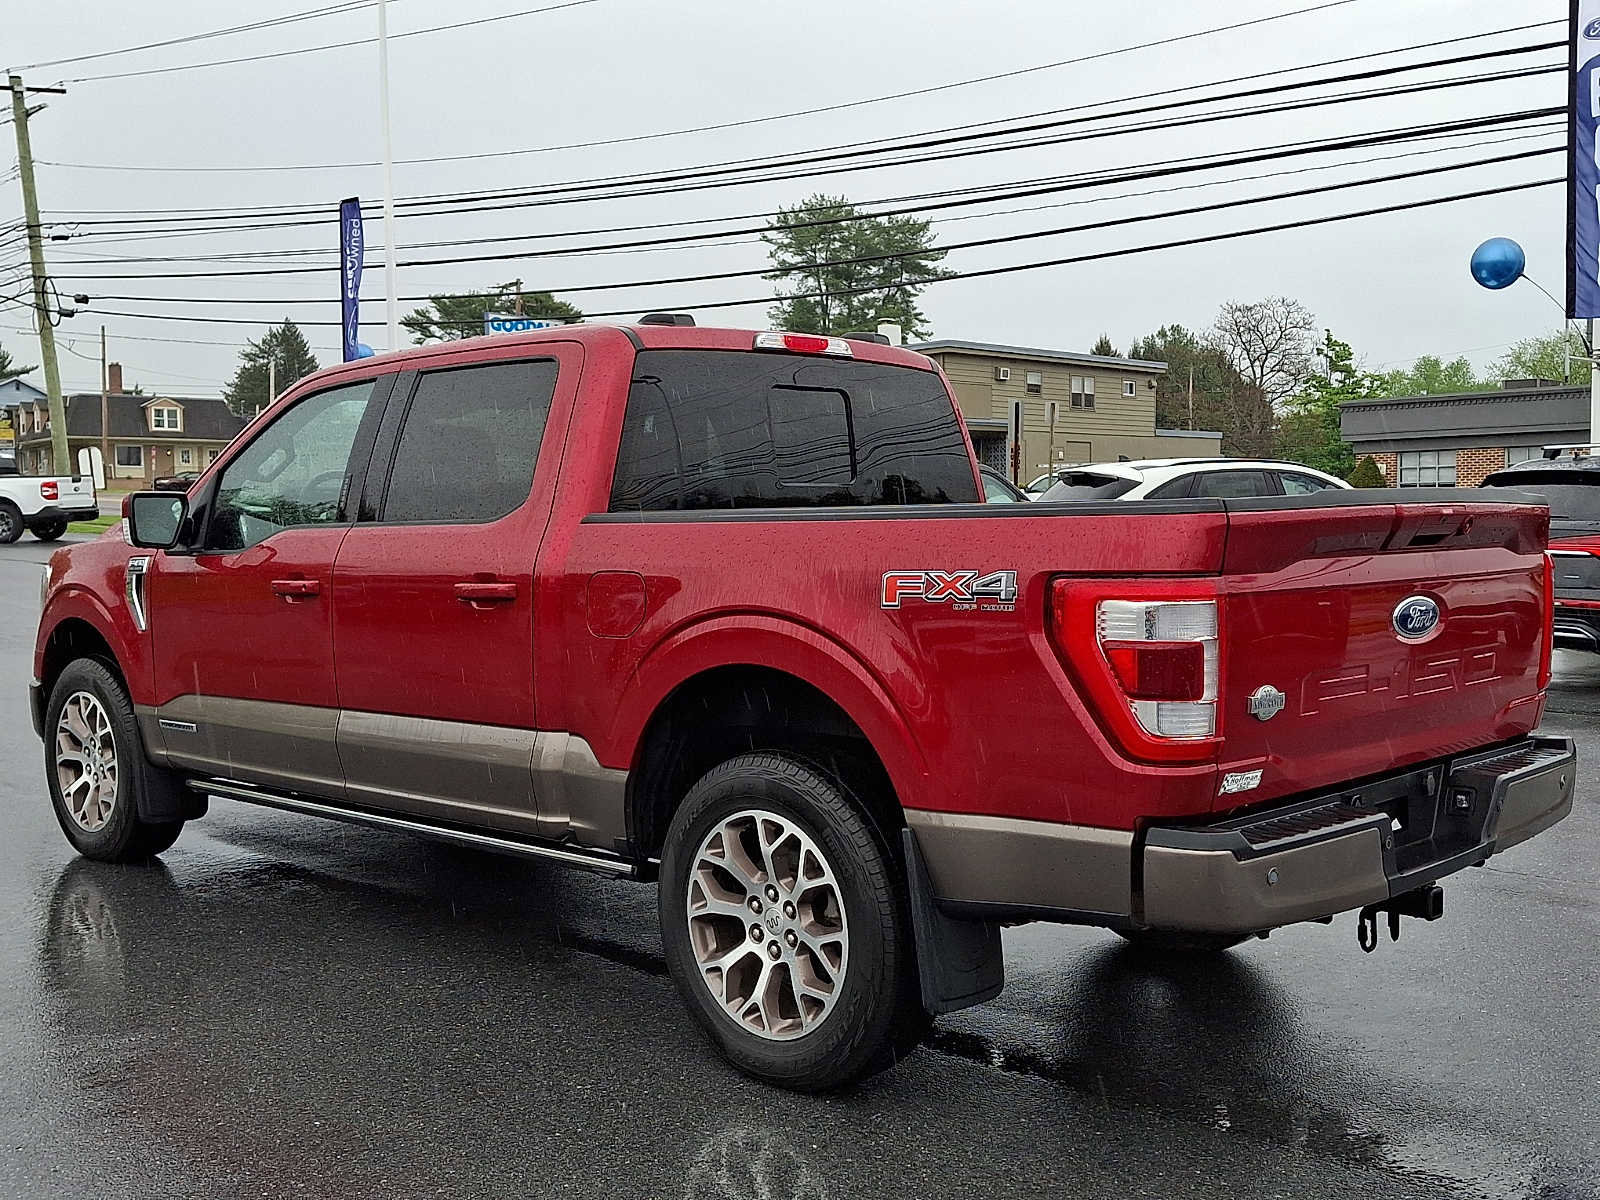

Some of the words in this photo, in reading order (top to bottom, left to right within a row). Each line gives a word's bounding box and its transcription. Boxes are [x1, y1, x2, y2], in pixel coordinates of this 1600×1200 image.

[490, 317, 559, 332] GOODA
[881, 570, 1018, 610] FX4
[1407, 605, 1434, 629] Ford
